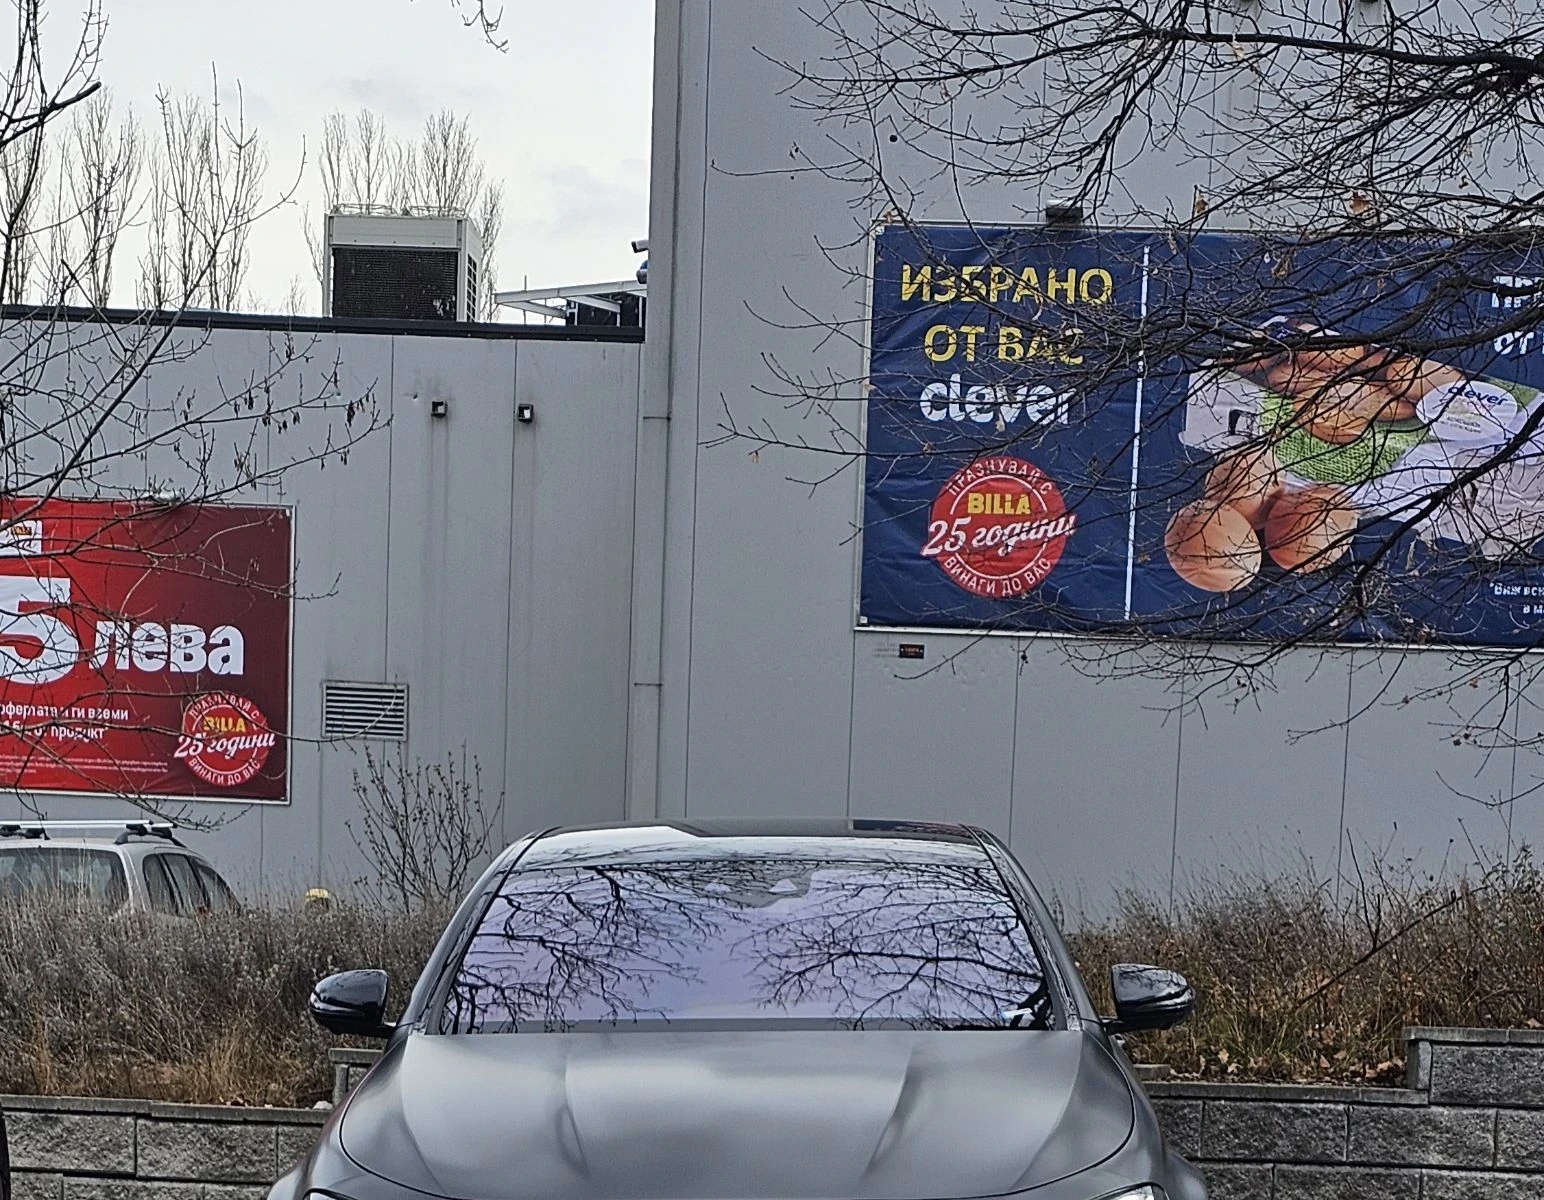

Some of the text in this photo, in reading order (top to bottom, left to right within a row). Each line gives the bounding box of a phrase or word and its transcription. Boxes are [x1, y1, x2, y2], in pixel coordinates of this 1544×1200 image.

[901, 264, 1114, 305] ИЗБРАНО
[924, 324, 1085, 365] ОТ ВАС
[919, 373, 1078, 425] clever
[946, 459, 1053, 496] ПРАЗНУВАЙ С
[967, 492, 1031, 515] BILLA
[920, 514, 1078, 557] 25 години
[944, 556, 1052, 597] ВИНАГИ ДО ВАС
[0, 574, 245, 686] 5 лева
[72, 706, 85, 719] ги
[88, 707, 129, 720] вземи
[188, 693, 252, 720] ПРАЗНВАЙ
[203, 716, 247, 733] BILLA
[173, 732, 276, 760] 25 години
[188, 758, 225, 785] ВИНАГИ
[227, 773, 241, 786] ДО
[243, 758, 261, 779] ВАС
